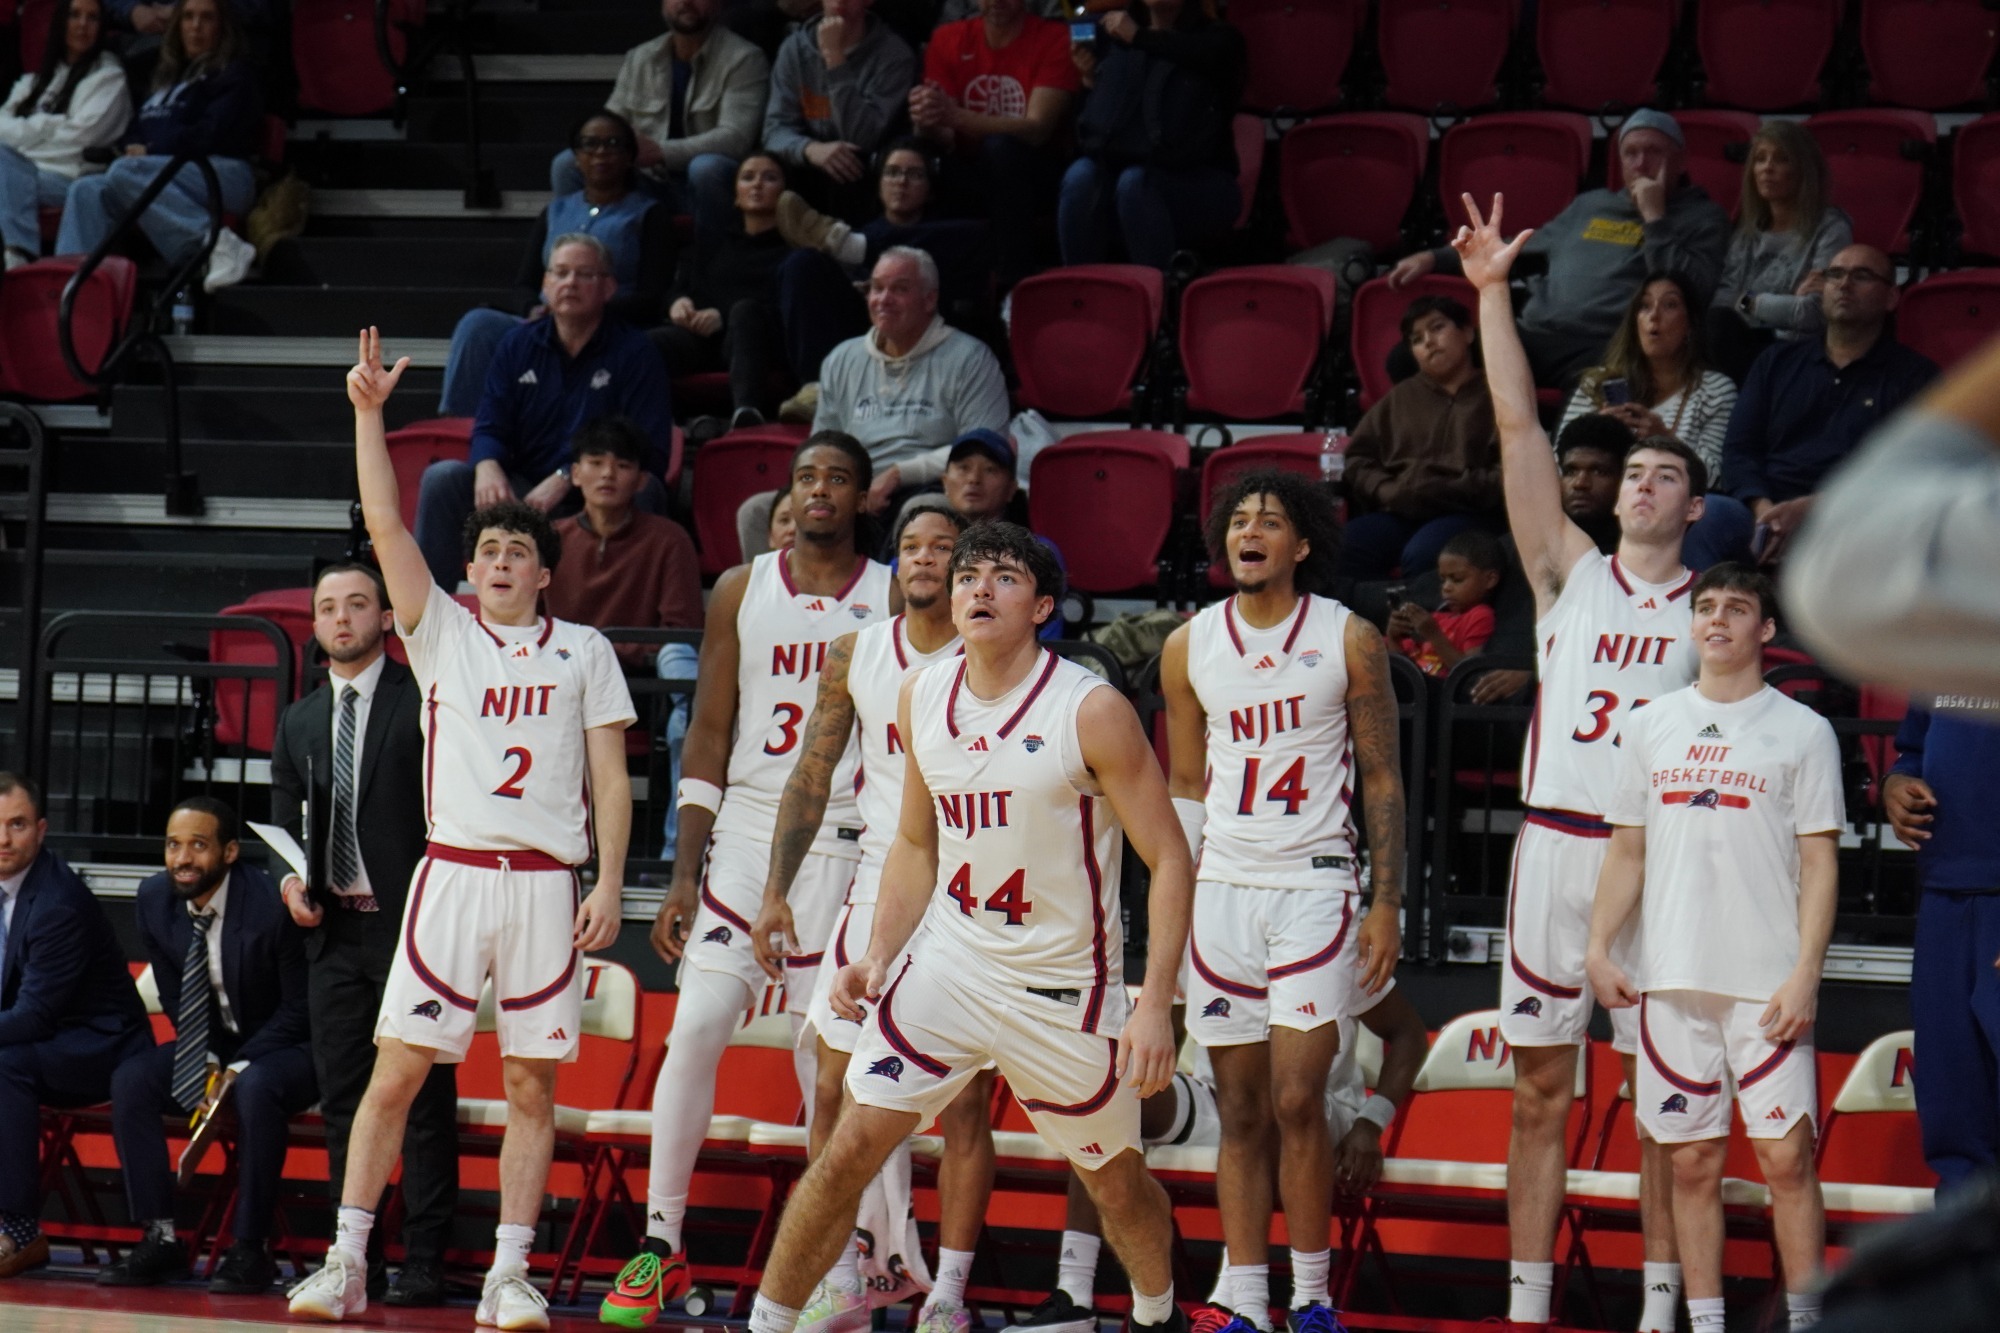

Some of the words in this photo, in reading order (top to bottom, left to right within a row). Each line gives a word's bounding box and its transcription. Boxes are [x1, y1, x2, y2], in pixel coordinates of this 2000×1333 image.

[1592, 632, 1677, 672] NJIT
[480, 684, 557, 726] NJIT
[1230, 694, 1306, 748] NJIT
[1571, 689, 1652, 749] 3
[491, 746, 533, 800] 2
[1652, 768, 1767, 793] BASKETBALL
[1686, 745, 1732, 765] NJIT
[1237, 756, 1309, 816] 14
[938, 790, 1014, 840] NJIT
[947, 862, 1033, 926] 44
